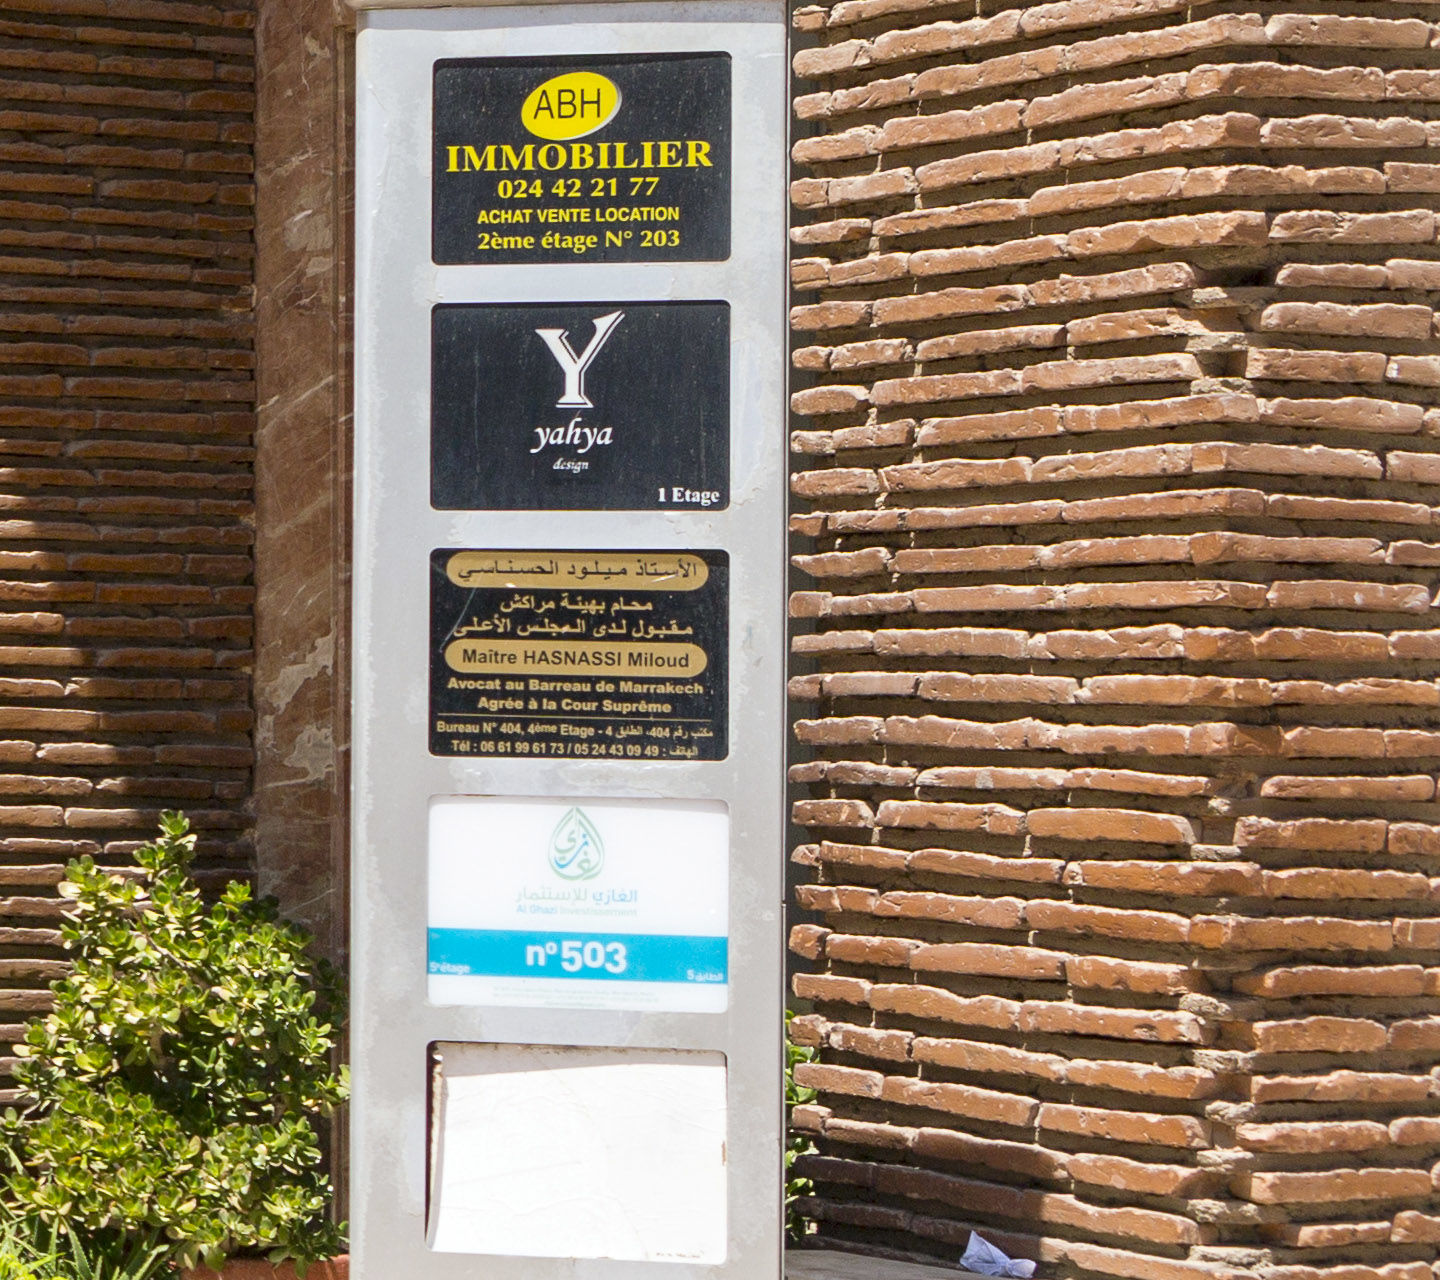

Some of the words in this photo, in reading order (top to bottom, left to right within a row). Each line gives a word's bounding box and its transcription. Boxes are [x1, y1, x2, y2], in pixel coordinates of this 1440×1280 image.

[533, 88, 601, 119] ABH
[446, 141, 713, 172] IMMOBILIER
[498, 180, 543, 198] 024
[552, 179, 581, 197] 42
[590, 178, 617, 197] 21
[629, 177, 659, 196] 77
[477, 209, 533, 224] ACHAT
[537, 208, 591, 223] VENTE
[595, 207, 680, 222] LOCATION
[478, 232, 534, 250] 2ème
[541, 231, 597, 253] étage
[640, 230, 680, 247] 203
[535, 310, 626, 408] Y
[530, 411, 613, 454] yahya
[552, 458, 589, 473] design
[658, 487, 666, 503] 1
[672, 487, 720, 507] Etage
[458, 560, 558, 581] الحسناسي
[567, 561, 627, 580] ميلود
[636, 559, 697, 578] الأستاذ
[500, 594, 555, 613] مراكش
[611, 598, 653, 616] محام
[517, 619, 585, 635] المجلس
[632, 620, 693, 637] مقبول
[462, 648, 517, 666] Maître
[524, 650, 622, 667] HASNASSI
[628, 652, 690, 668] Miloud
[447, 677, 501, 691] Avocat
[505, 680, 524, 691] au
[529, 679, 591, 692] Barreau
[595, 680, 614, 693] de
[619, 681, 704, 695] Marrakech
[477, 696, 524, 711] Agrée
[528, 696, 538, 710] à
[542, 698, 556, 710] la
[561, 698, 598, 712] Cour
[602, 699, 672, 714] Suprême
[480, 741, 495, 752] 06
[498, 742, 511, 752] 61
[515, 742, 529, 753] 99
[532, 742, 546, 753] 61
[550, 742, 564, 754] 73
[574, 744, 588, 754] 05
[592, 744, 606, 755] 24
[609, 744, 624, 755] 43
[626, 745, 641, 756] 09
[644, 745, 659, 756] 49
[561, 940, 627, 973] 503
